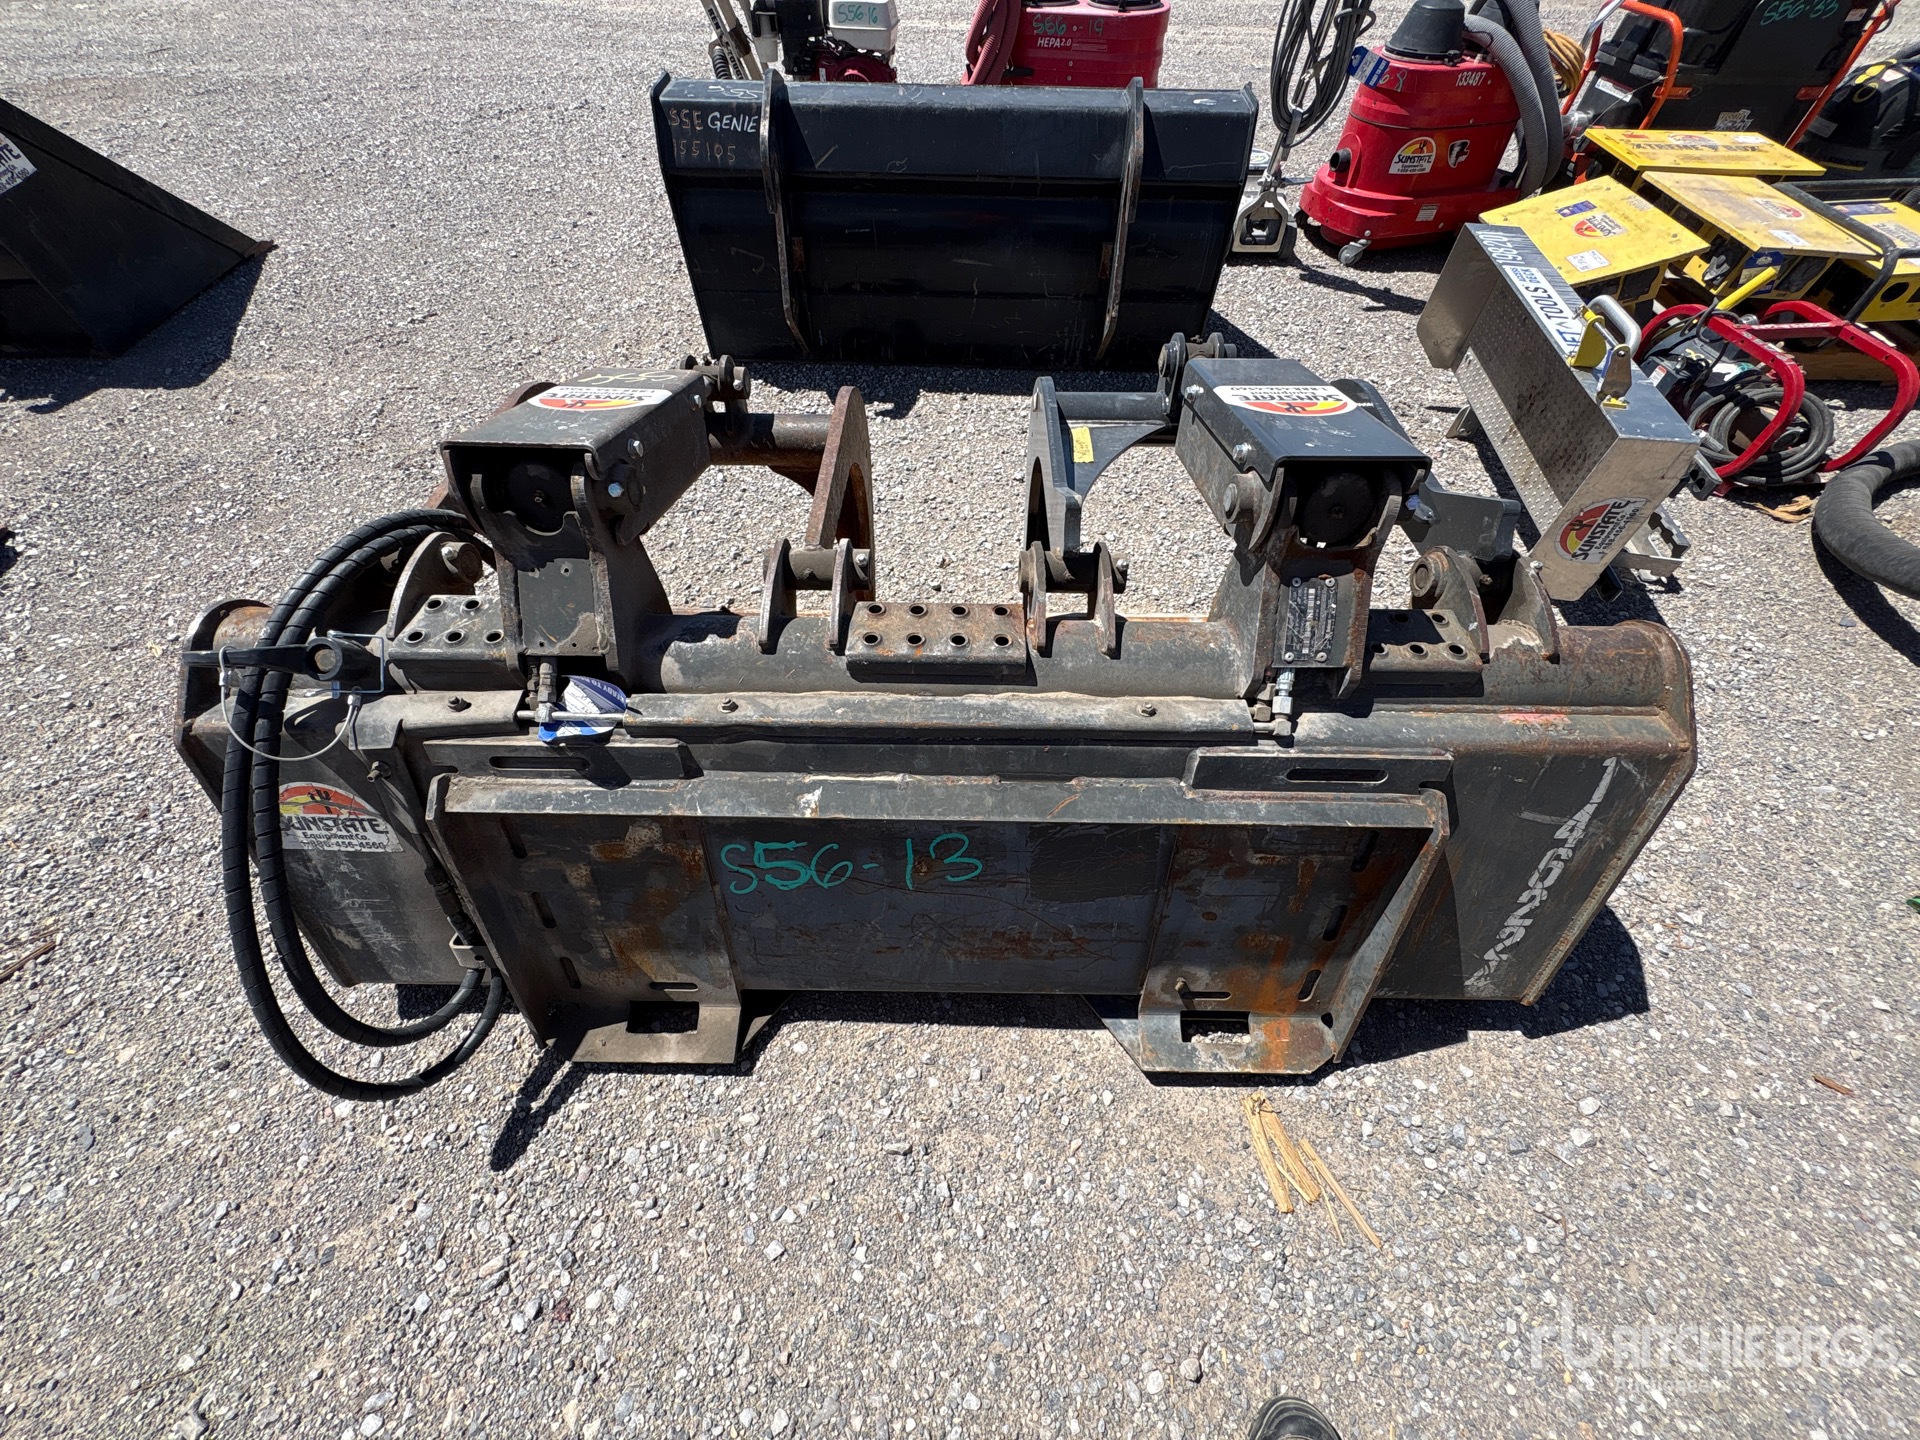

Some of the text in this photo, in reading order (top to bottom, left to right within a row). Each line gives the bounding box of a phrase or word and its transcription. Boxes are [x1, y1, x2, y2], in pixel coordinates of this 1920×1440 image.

[1037, 37, 1061, 48] HEPA
[1061, 38, 1072, 47] 2.0
[1455, 71, 1487, 87] 133487
[707, 111, 759, 132] GENIE
[1394, 154, 1433, 164] SUNSTATE
[1475, 230, 1527, 265] 198201
[1520, 268, 1542, 284] DECK
[1524, 284, 1569, 320] TOOLS
[544, 392, 653, 400] SUNSTATE
[1231, 394, 1344, 402] SUNSTATE
[1571, 500, 1634, 561] SUNSTATE
[302, 832, 371, 841] Equipment Co.
[720, 833, 983, 895] S56-13
